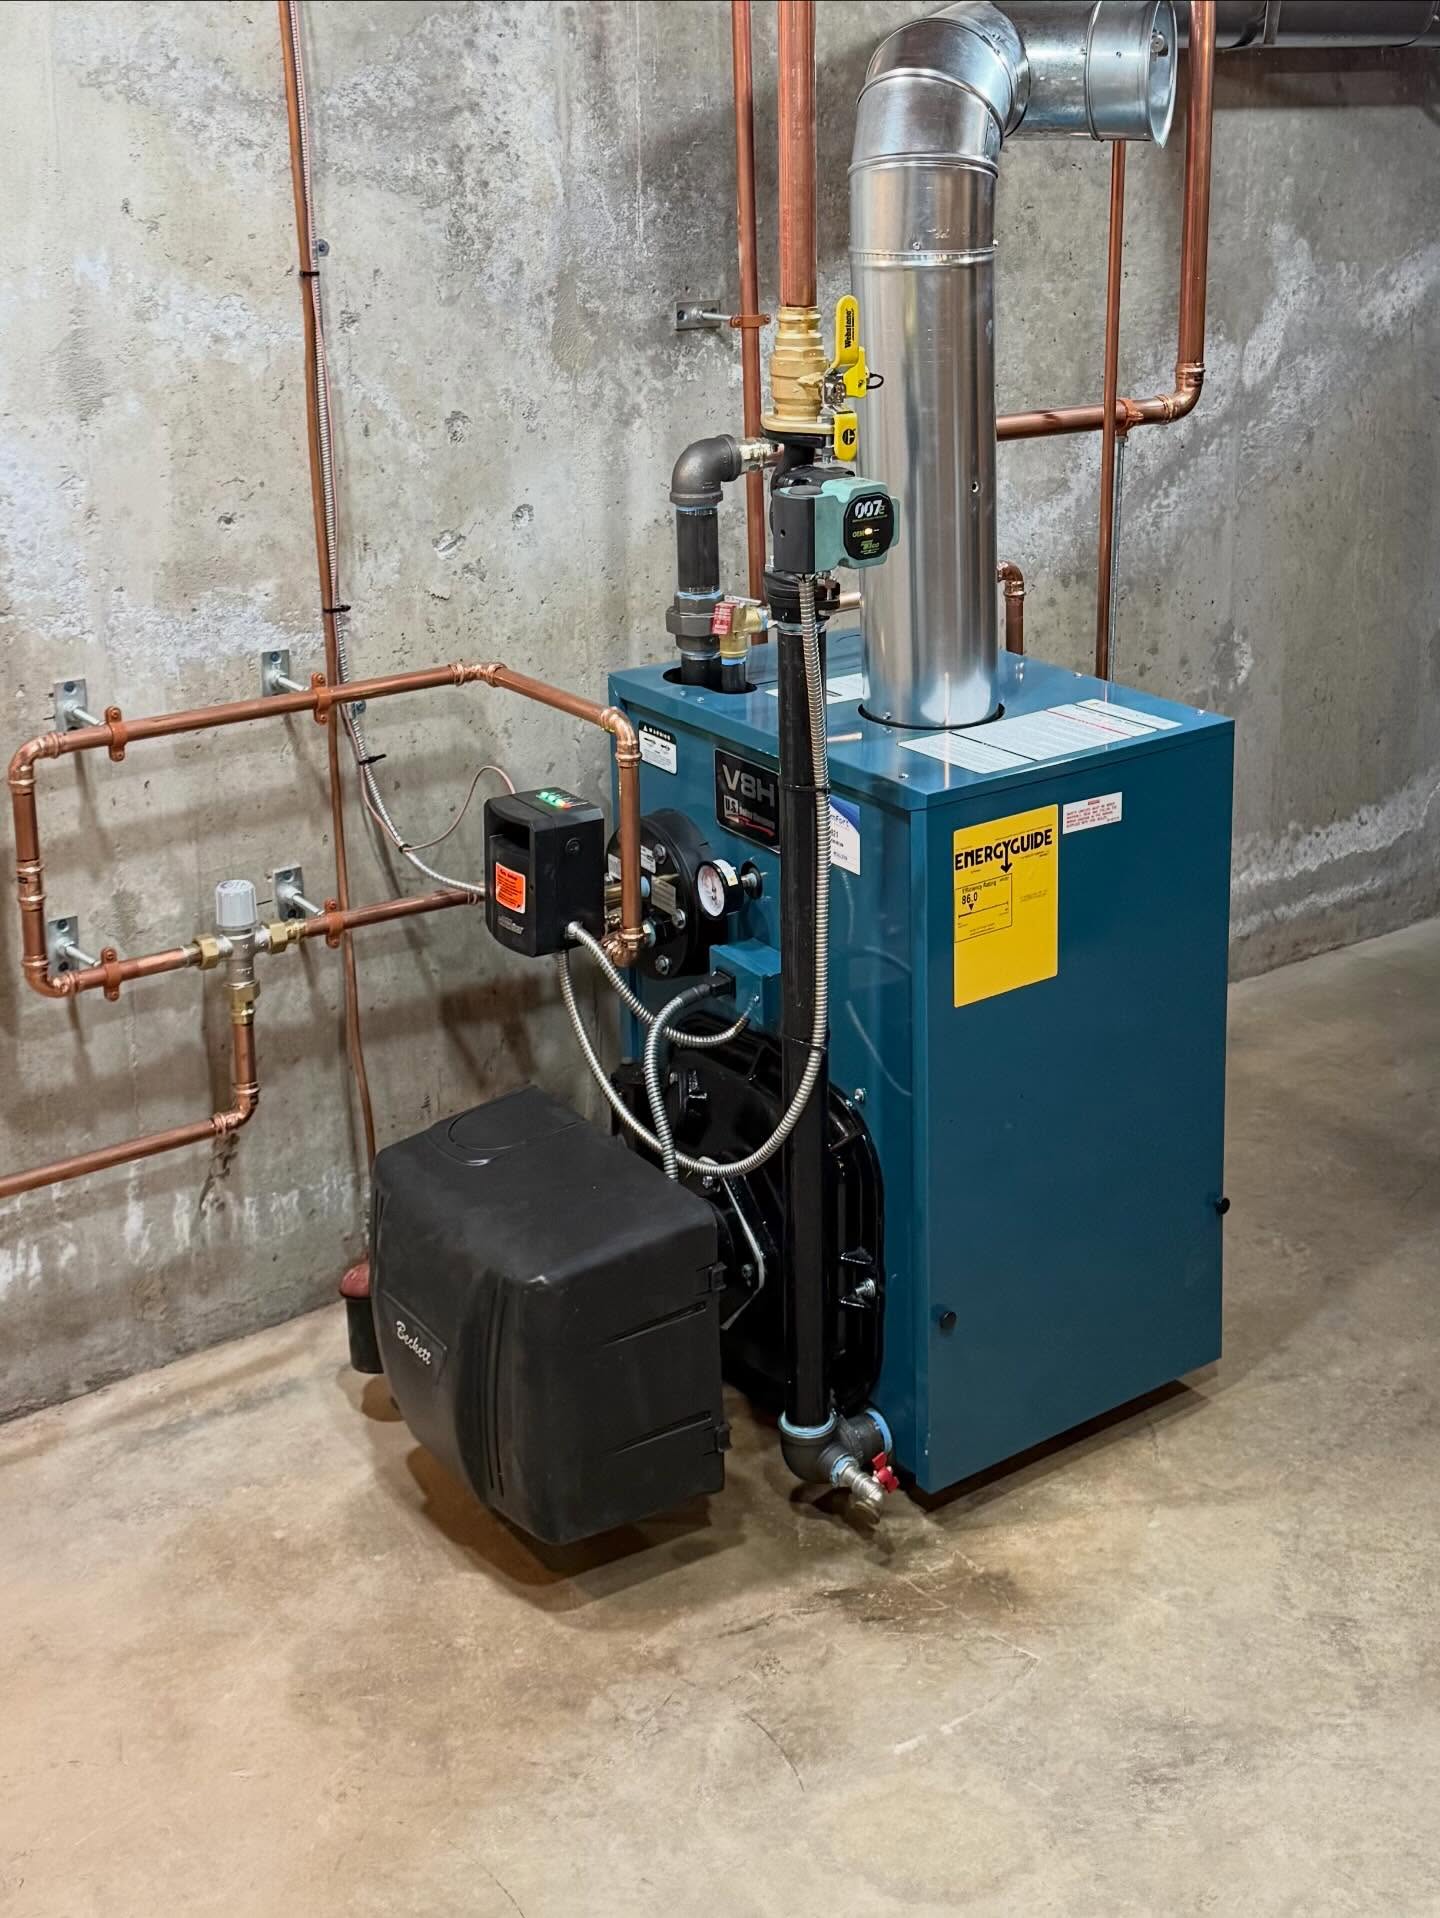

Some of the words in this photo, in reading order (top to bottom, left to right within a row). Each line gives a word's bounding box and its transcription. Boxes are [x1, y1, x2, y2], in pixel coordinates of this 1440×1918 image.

[722, 764, 775, 808] V8H
[955, 828, 1053, 873] ENERGYGUIDE
[961, 891, 978, 905] 86.0
[962, 884, 983, 895] Efficiency
[983, 880, 997, 889] Rating
